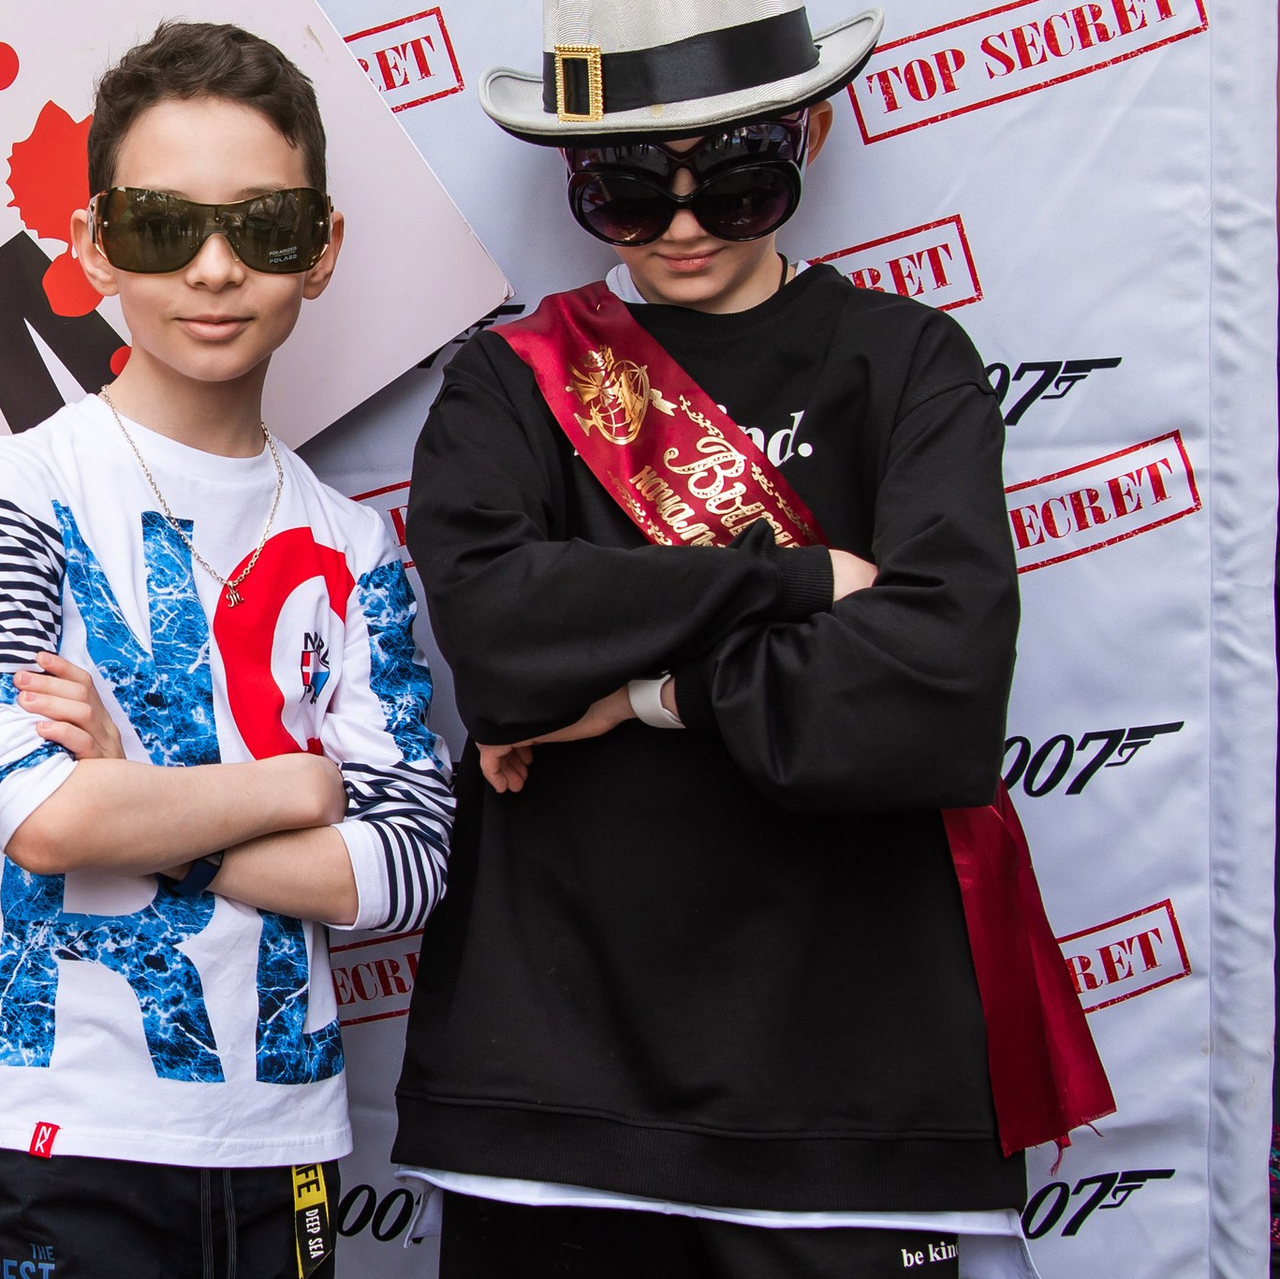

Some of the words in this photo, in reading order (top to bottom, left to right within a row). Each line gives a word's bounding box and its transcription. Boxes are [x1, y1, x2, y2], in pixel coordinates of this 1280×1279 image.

[865, 48, 966, 114] TOP
[844, 243, 953, 298] RET
[1008, 458, 1173, 551] ECRET
[331, 951, 421, 1006] ECR
[1066, 927, 1164, 996] RET
[305, 1208, 321, 1234] DEEP
[338, 1184, 424, 1243] 00
[1020, 1172, 1120, 1240] 07
[30, 1243, 56, 1261] THE
[308, 1237, 325, 1259] SEA
[901, 1248, 925, 1268] be
[928, 1241, 959, 1262] kin
